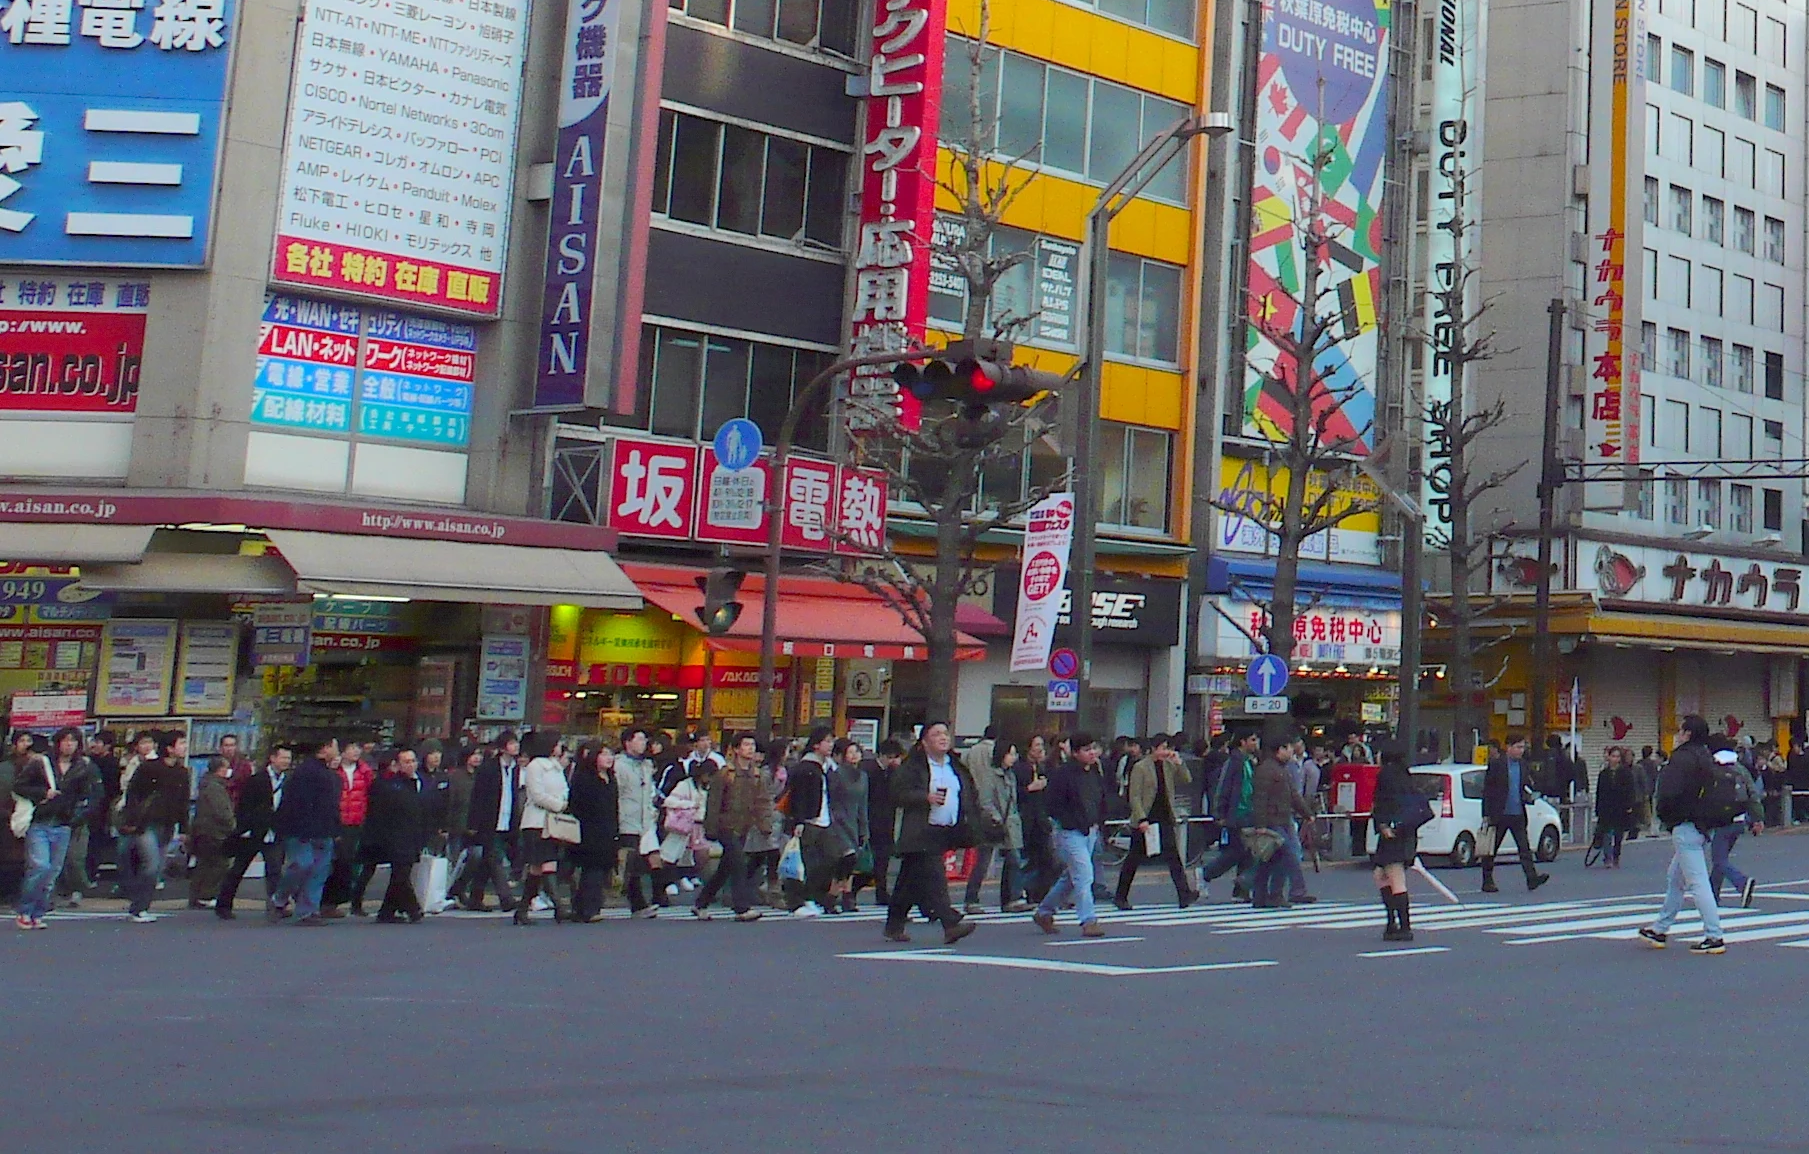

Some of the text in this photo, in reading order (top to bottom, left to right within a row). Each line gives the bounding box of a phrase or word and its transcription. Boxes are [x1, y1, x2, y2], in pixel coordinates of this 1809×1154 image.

[1277, 25, 1376, 80] DUTY FREE
[1612, 17, 1629, 86] STORE
[286, 242, 490, 304] 各社 特約 在庫 直販
[548, 134, 594, 376] AISAN
[18, 279, 57, 306] 特約
[67, 280, 105, 308] 在庫
[617, 449, 881, 548] 坂電熱
[1662, 554, 1803, 613] ナカウラ
[1250, 610, 1382, 645] 秋原免税中心
